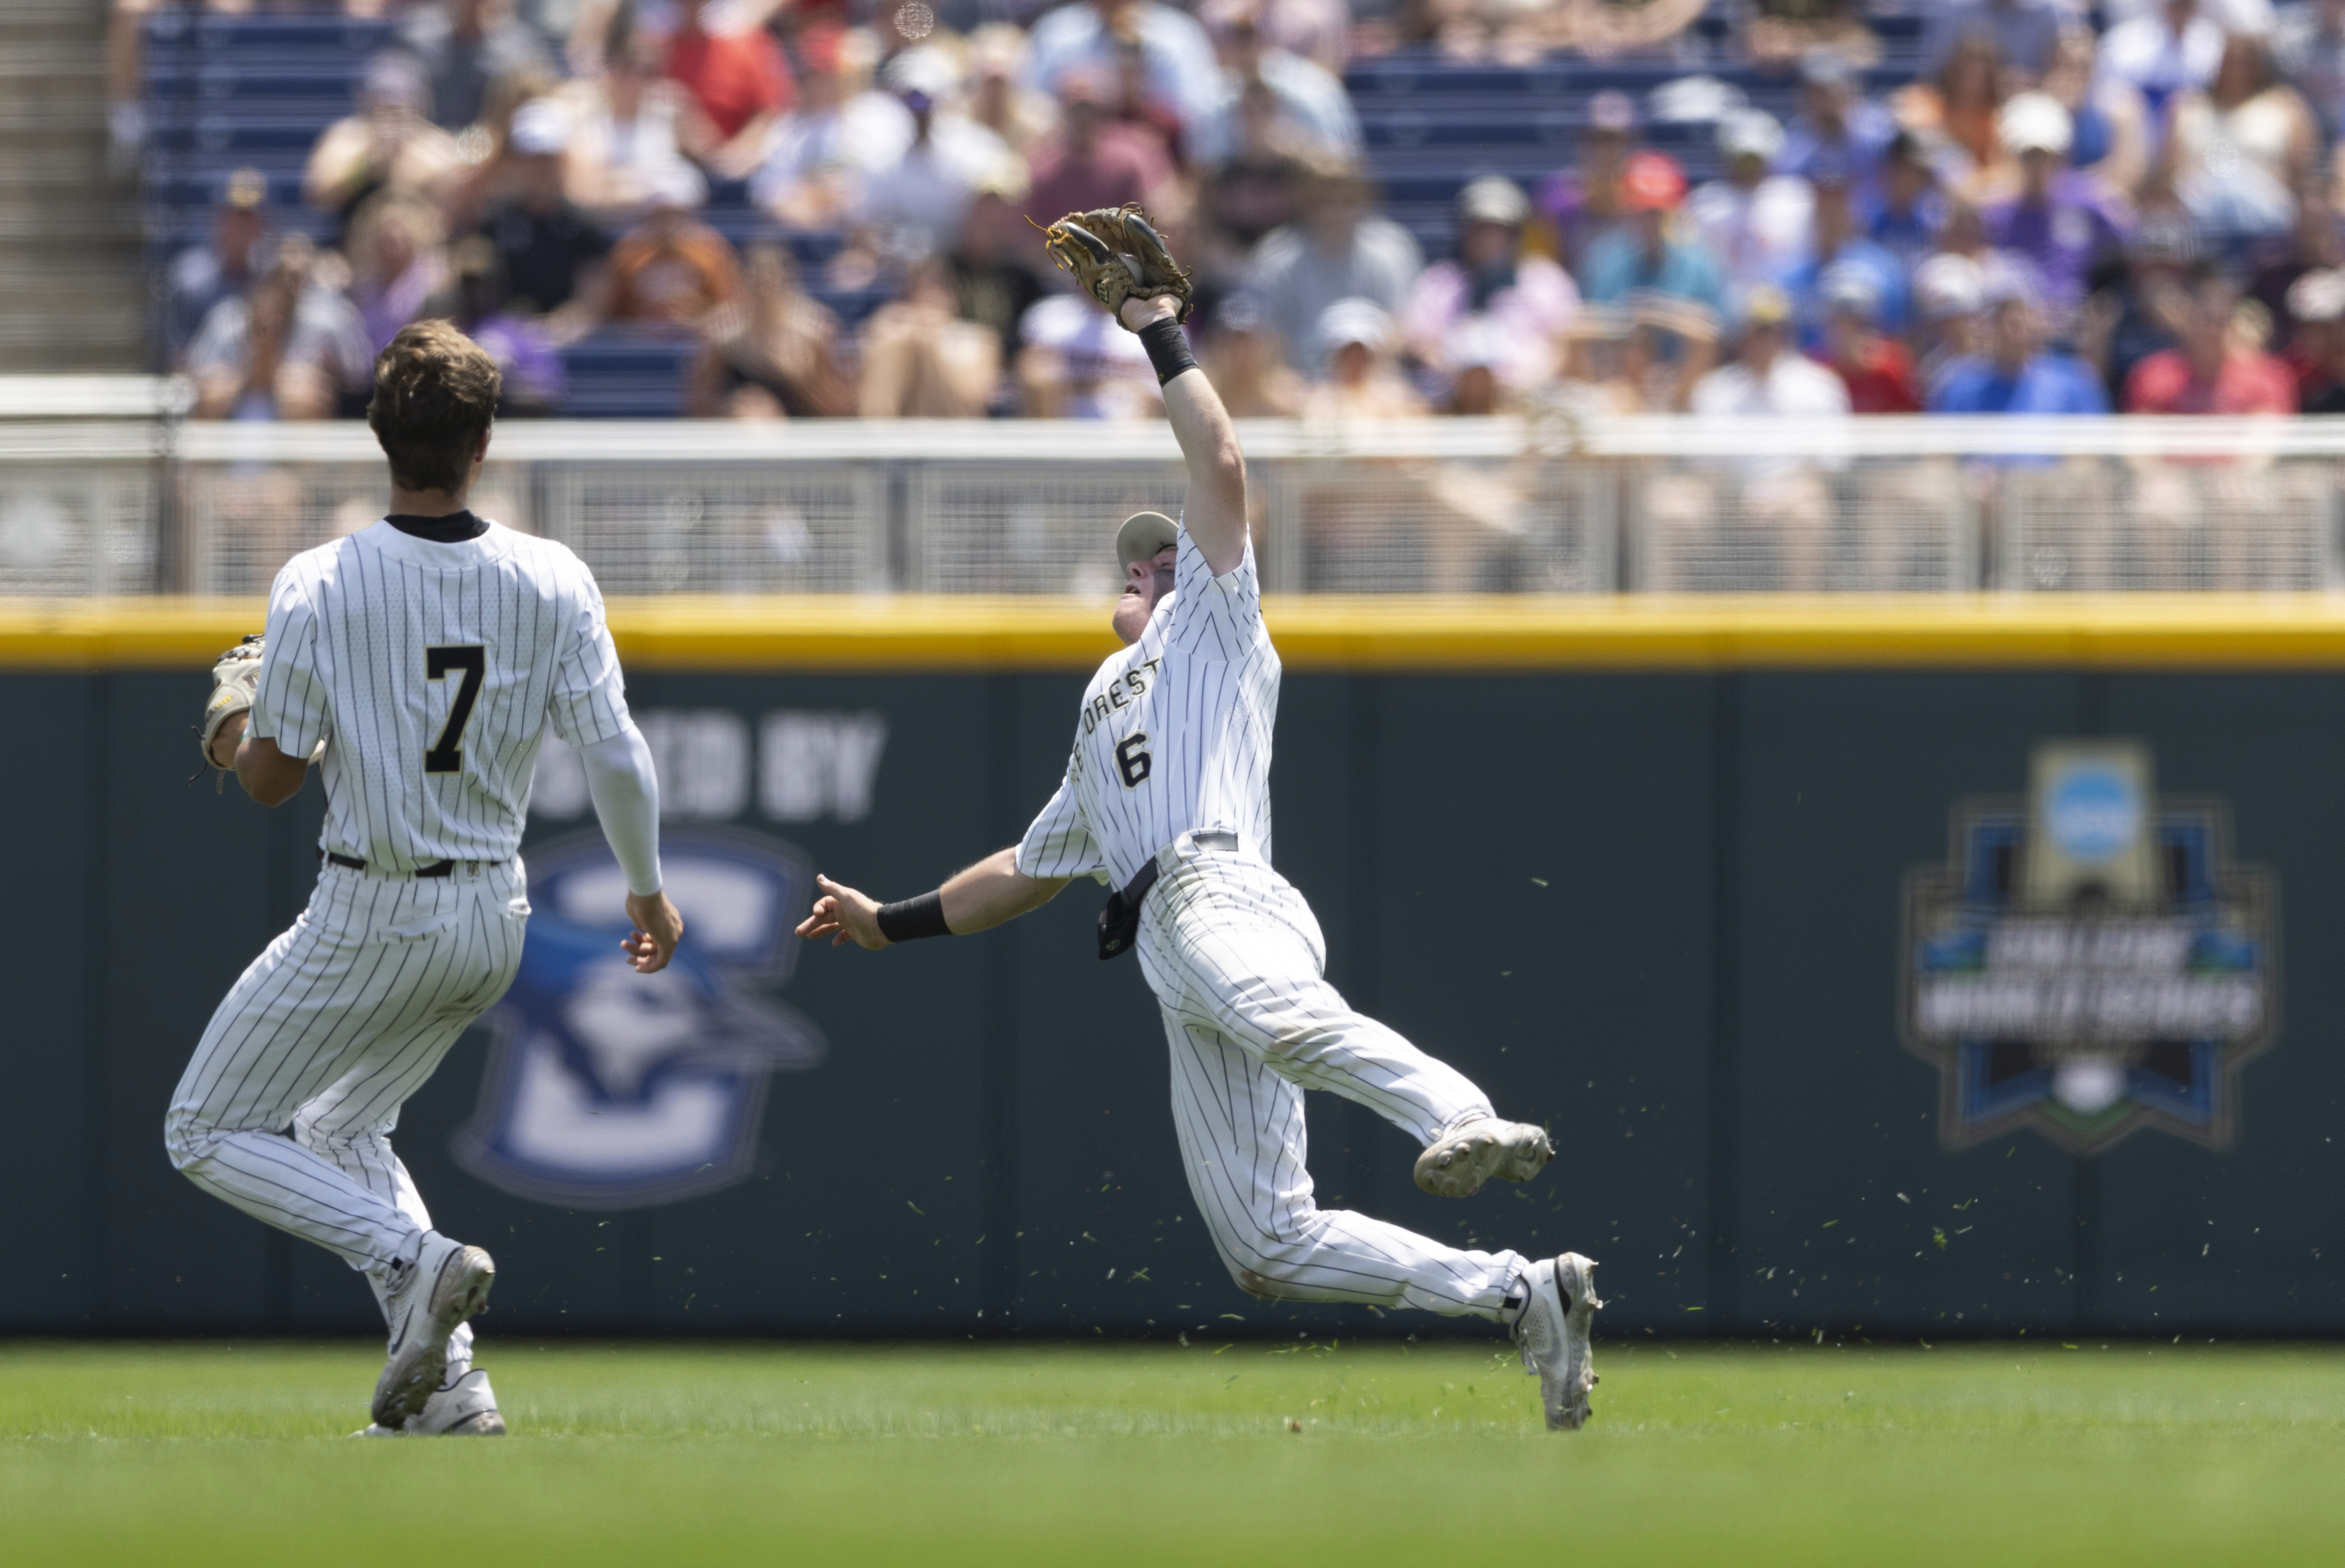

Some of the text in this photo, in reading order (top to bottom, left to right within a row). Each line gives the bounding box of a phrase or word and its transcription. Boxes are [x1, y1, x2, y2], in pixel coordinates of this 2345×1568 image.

[424, 644, 486, 775] 7
[1083, 657, 1160, 738] OREST
[760, 710, 887, 822] BY
[1114, 730, 1153, 791] 6
